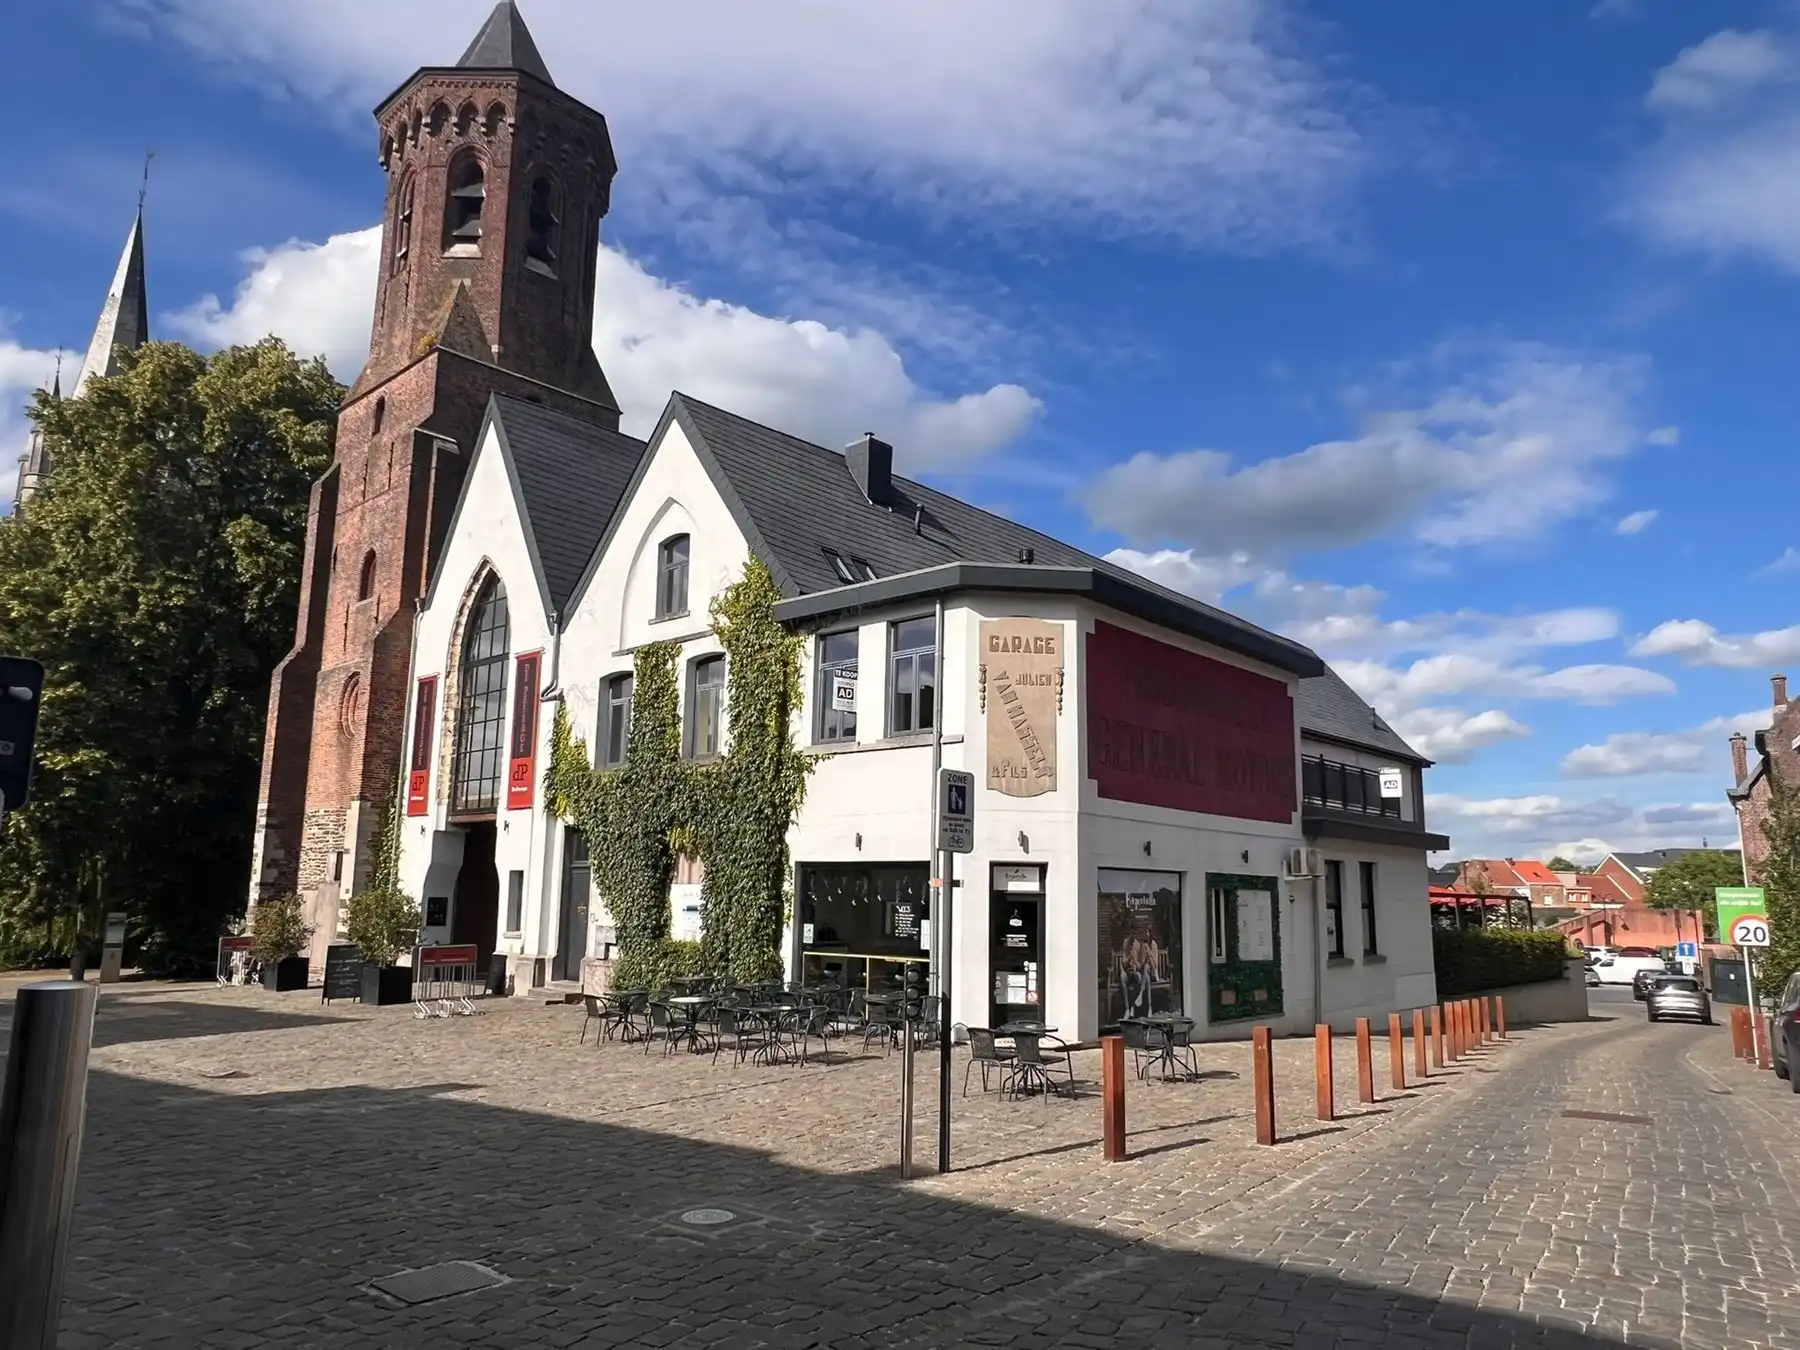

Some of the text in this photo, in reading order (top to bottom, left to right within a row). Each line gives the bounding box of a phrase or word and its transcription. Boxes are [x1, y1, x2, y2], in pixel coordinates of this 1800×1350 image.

[988, 635, 1056, 655] GARAGE
[1016, 673, 1052, 687] JULIEN
[838, 687, 853, 699] AD
[947, 773, 968, 785] ZONE
[1738, 926, 1766, 943] 20
